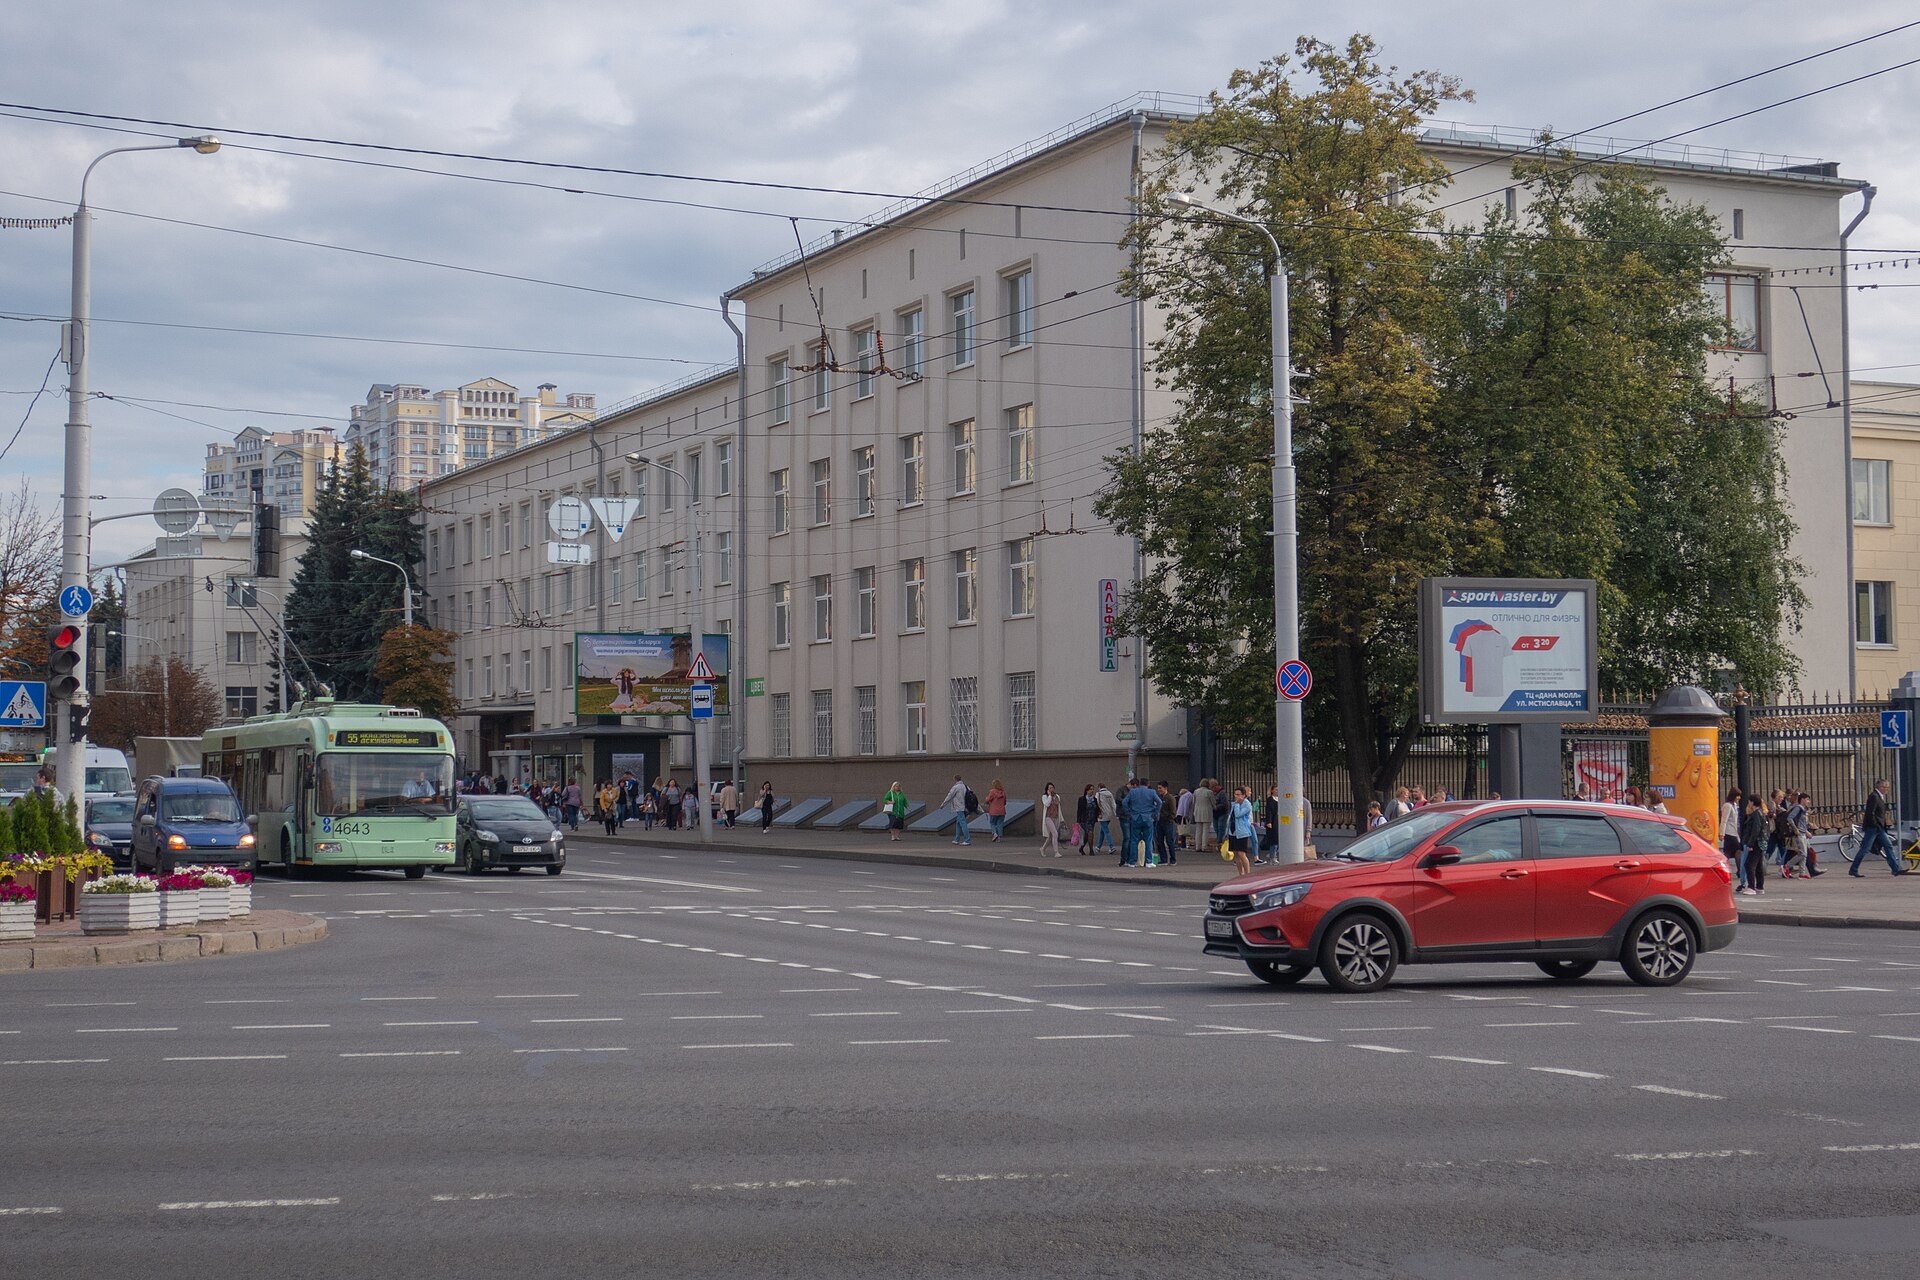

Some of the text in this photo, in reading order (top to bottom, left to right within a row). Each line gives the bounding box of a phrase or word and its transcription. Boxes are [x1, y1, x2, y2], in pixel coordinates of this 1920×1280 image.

[1460, 591, 1558, 604] sportmaster.by
[1491, 613, 1581, 623] ОТЛИЧНО ДЛЯ ФИЗРЫ
[347, 733, 359, 744] 55
[334, 822, 370, 835] 4643
